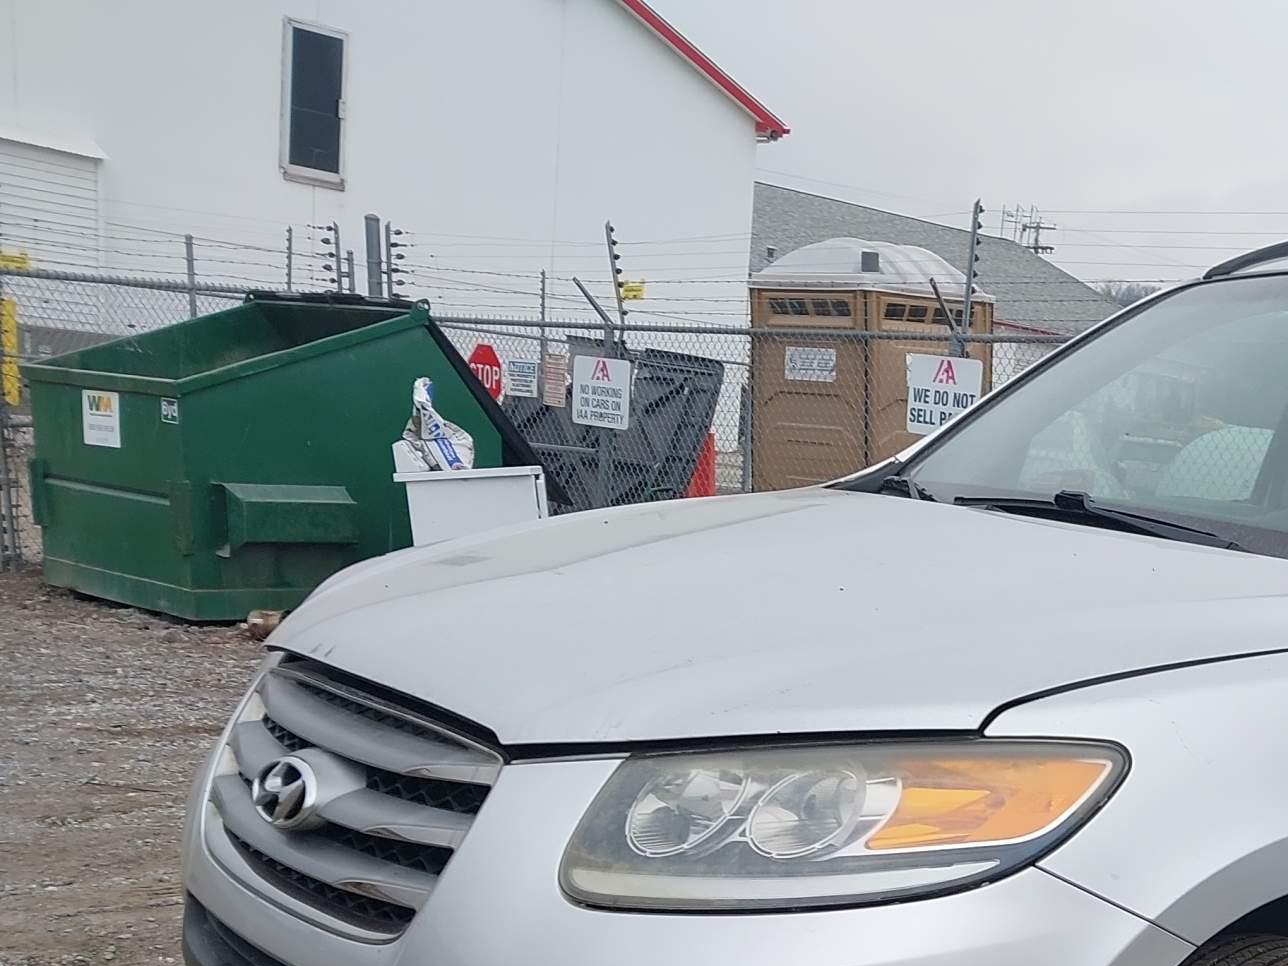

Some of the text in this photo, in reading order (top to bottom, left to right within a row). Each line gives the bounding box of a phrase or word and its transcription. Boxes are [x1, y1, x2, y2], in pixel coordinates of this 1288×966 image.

[580, 384, 622, 399] NO WORKING
[913, 387, 976, 409] WE DO NOT
[580, 396, 621, 411] ON CARS ON
[576, 408, 624, 425] IAA PROPERTY
[909, 407, 935, 425] SELL
